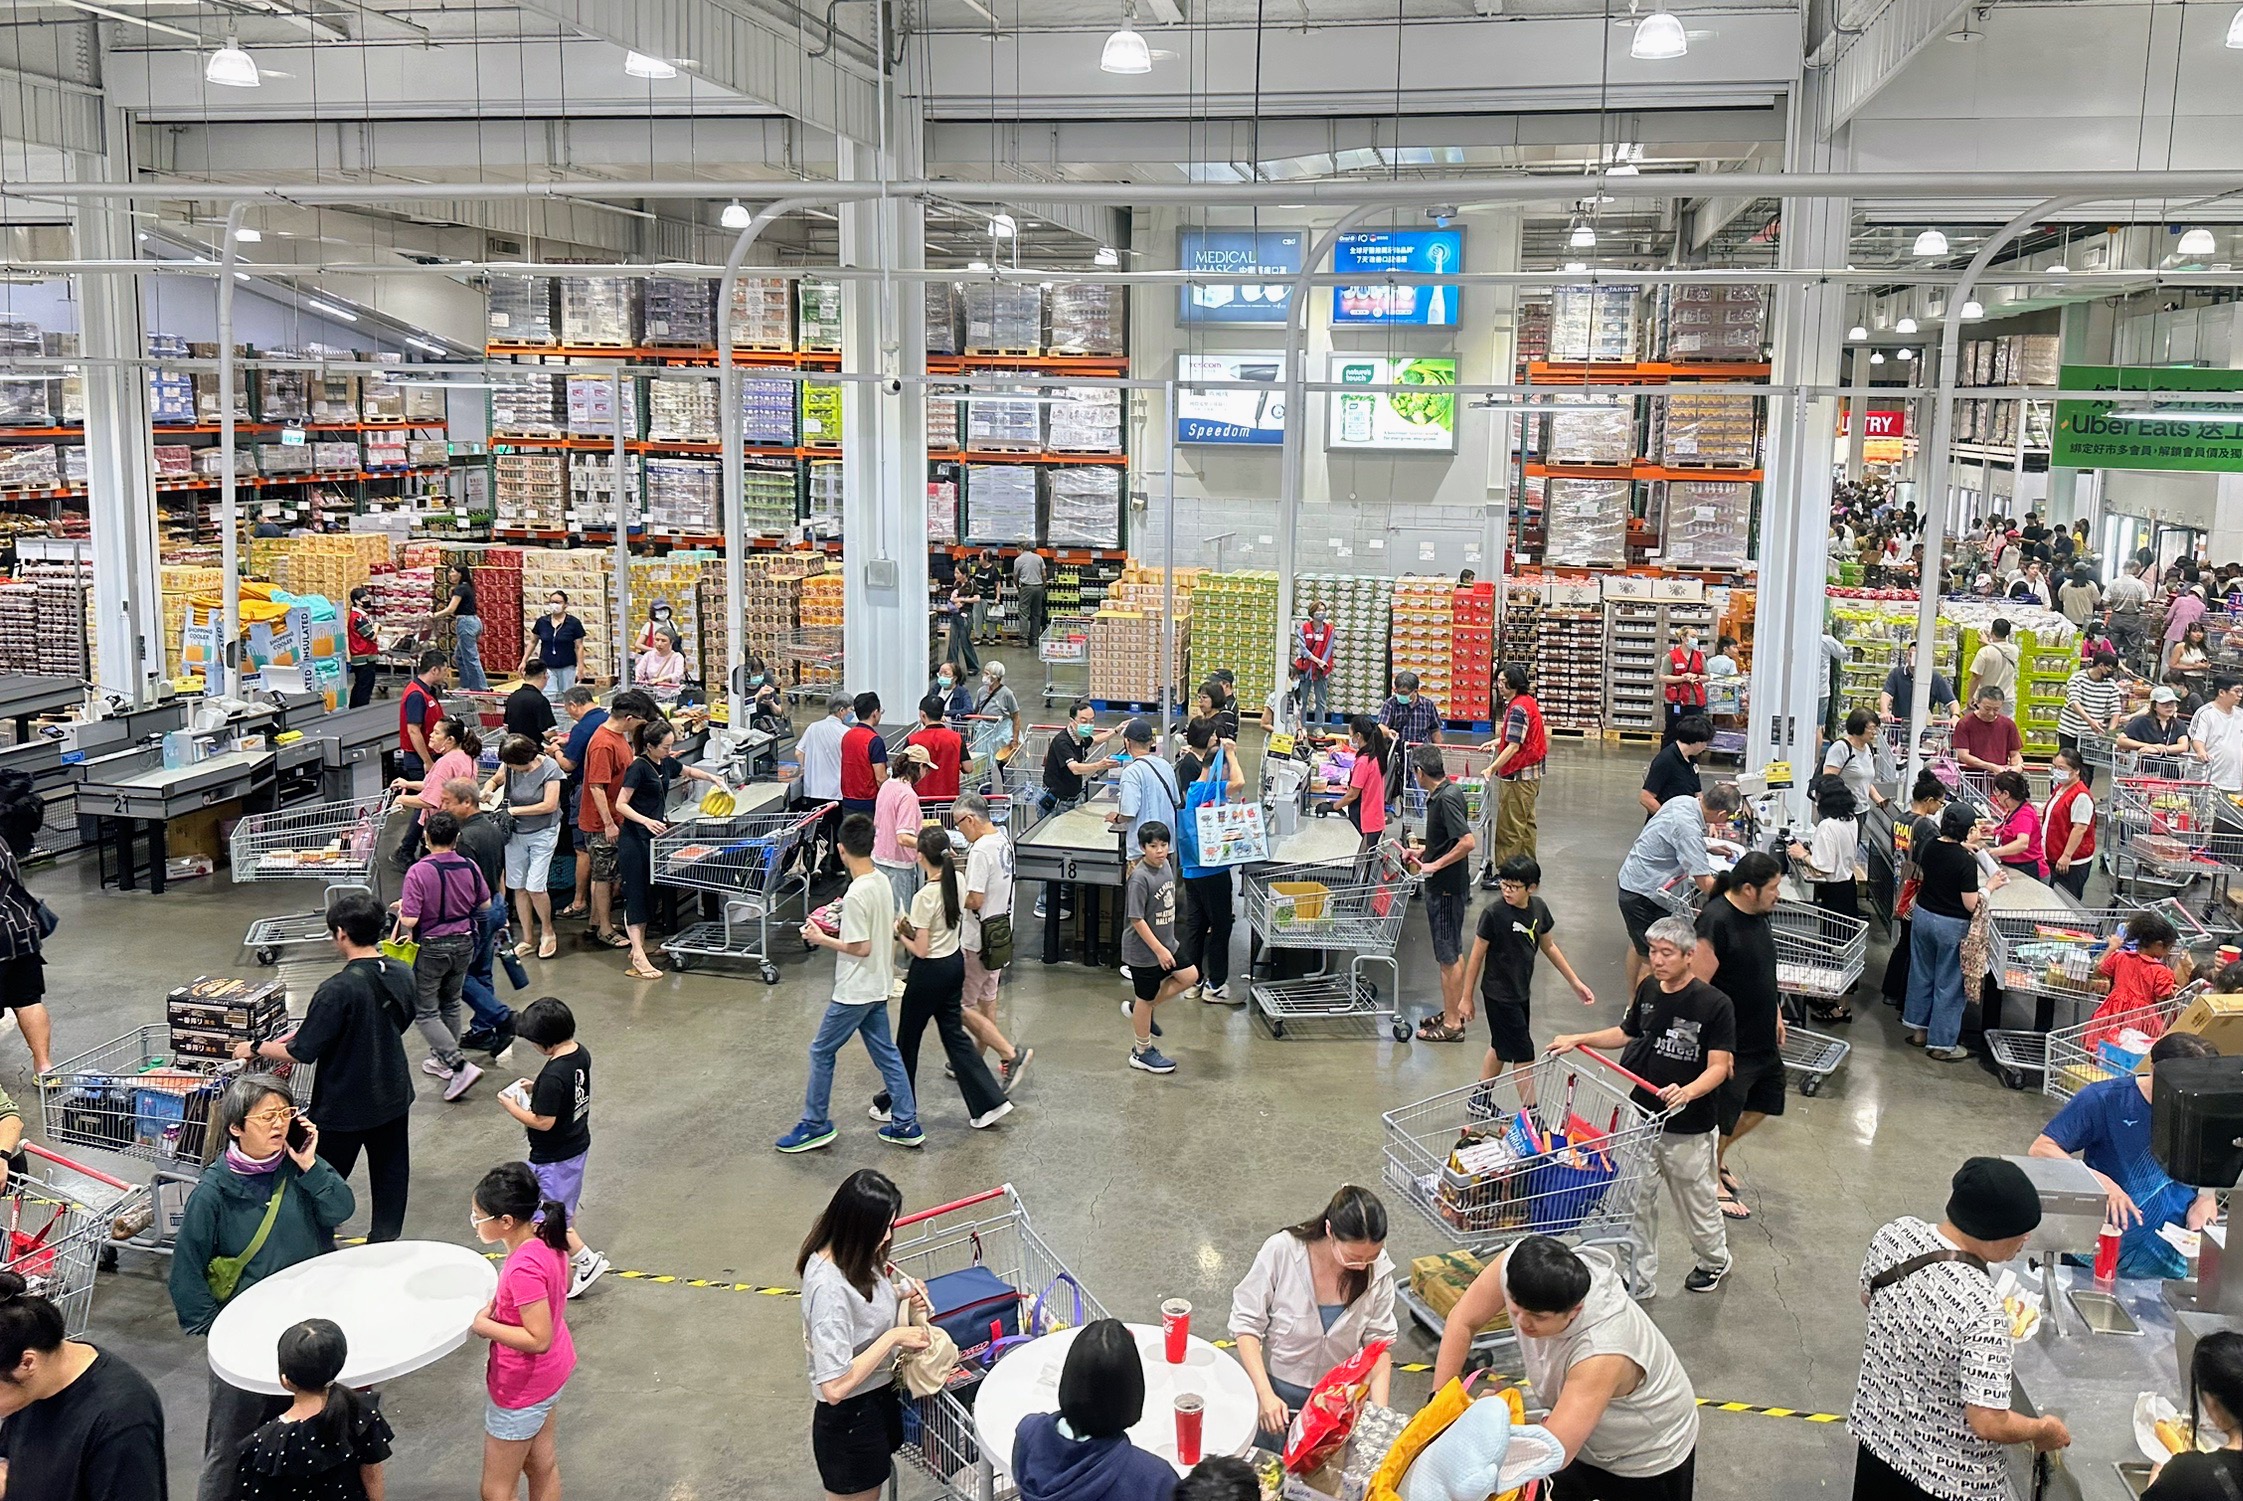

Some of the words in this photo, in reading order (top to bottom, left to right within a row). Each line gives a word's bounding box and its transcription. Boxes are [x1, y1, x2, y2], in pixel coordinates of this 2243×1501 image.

[1195, 250, 1256, 264] MEDICAL
[1188, 422, 1251, 440] Speedom
[2072, 414, 2134, 435] Uber
[2138, 420, 2190, 438] Eats
[187, 626, 213, 635] SHOPPING
[189, 633, 210, 641] COOLER
[269, 630, 295, 647] SHOPPING
[300, 612, 310, 662] INSULATED
[272, 637, 294, 651] COOLER
[113, 797, 129, 814] 21
[1057, 861, 1077, 880] 18
[1880, 1230, 1900, 1251] PUMA
[1900, 1227, 1926, 1252] PUMA
[1913, 1282, 1939, 1312] PUMA
[1938, 1284, 1966, 1315] PUMA
[1962, 1334, 2003, 1347] PUMA
[1960, 1364, 1998, 1381] PUMA
[1871, 1429, 1901, 1456] PUMA
[1893, 1429, 1924, 1456] PUMA
[1937, 1424, 1976, 1444] PUMA
[1911, 1458, 1948, 1483] PUMA
[1936, 1455, 1975, 1474] PUMA
[1961, 1480, 1997, 1490] PUMA
